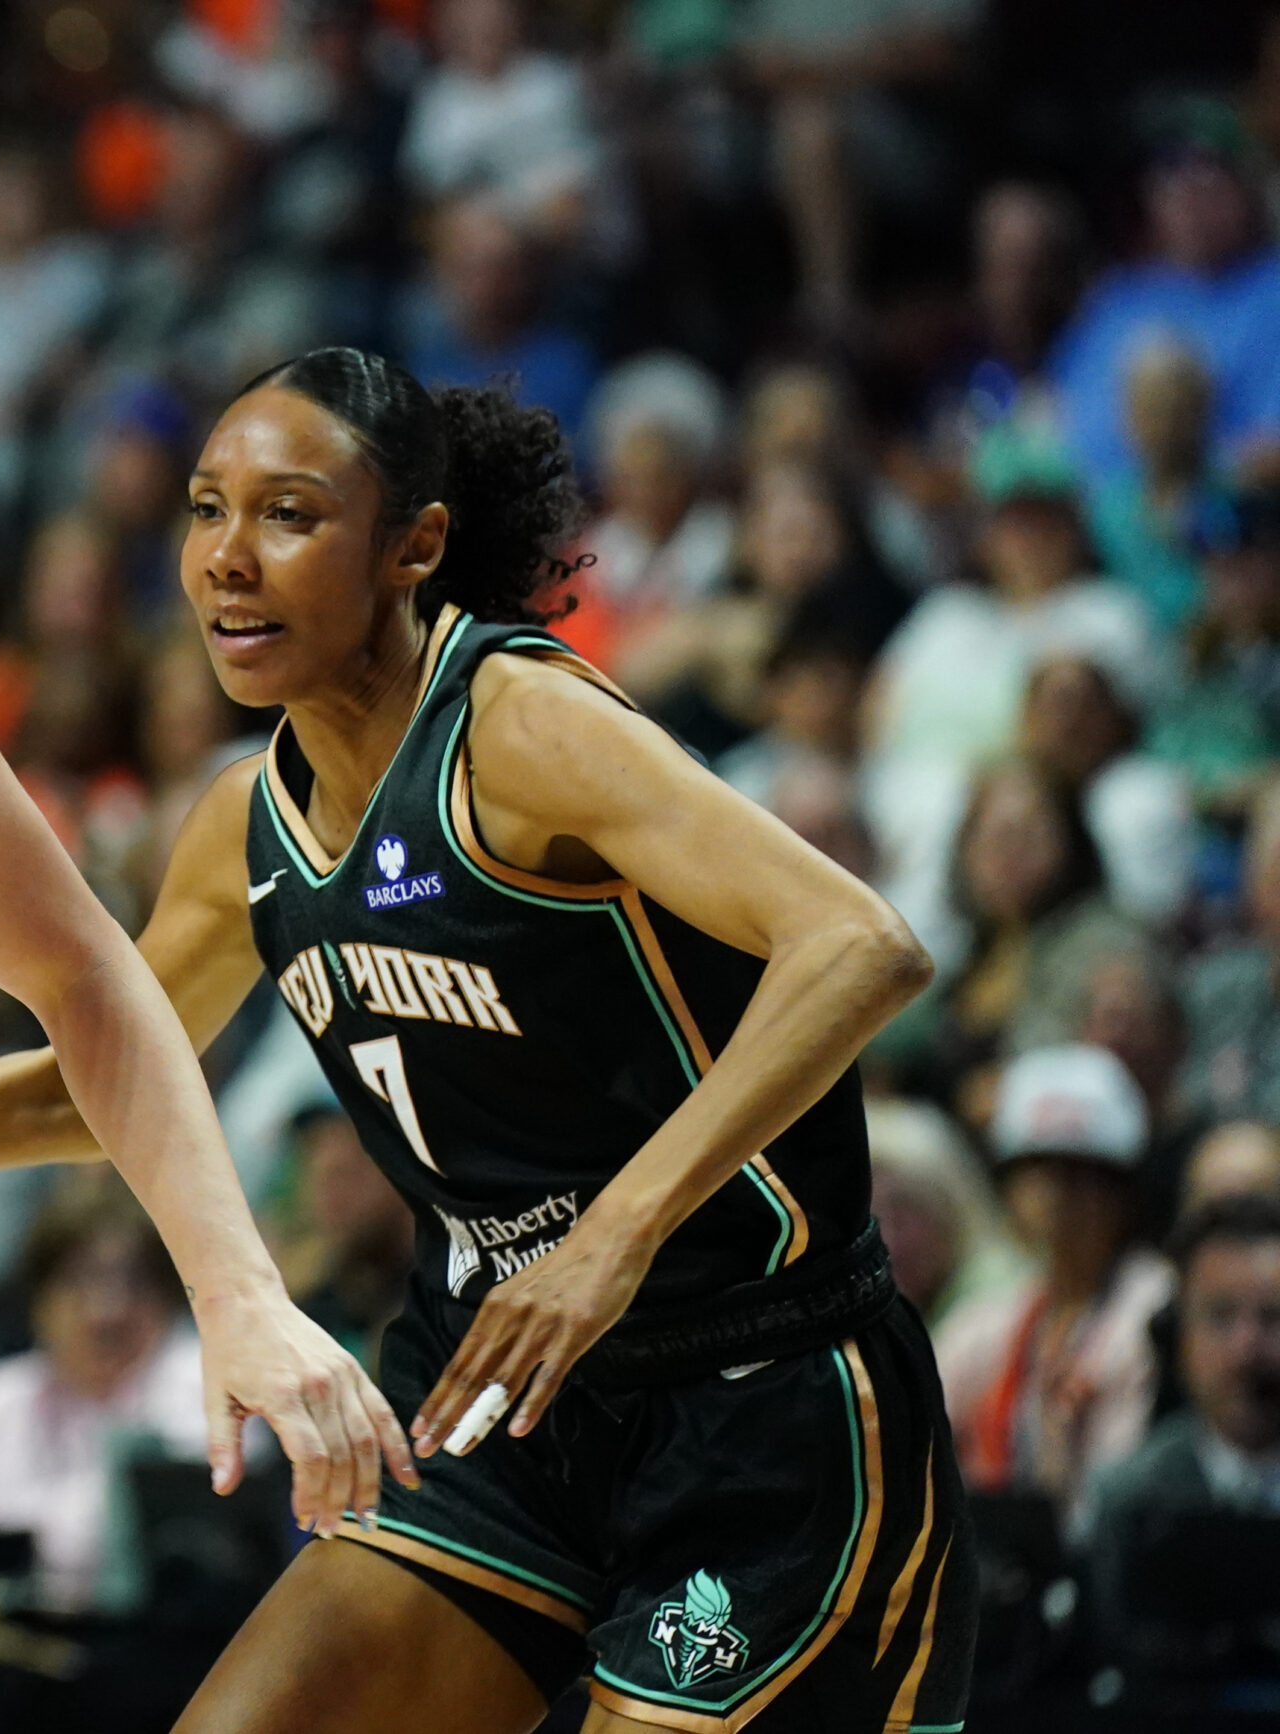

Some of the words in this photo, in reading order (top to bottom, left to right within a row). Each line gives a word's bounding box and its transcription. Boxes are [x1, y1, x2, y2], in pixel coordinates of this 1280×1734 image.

[366, 875, 442, 908] BARCLAYS
[339, 942, 523, 1037] YORK
[348, 1034, 448, 1179] 7
[468, 1190, 578, 1248] Liberty
